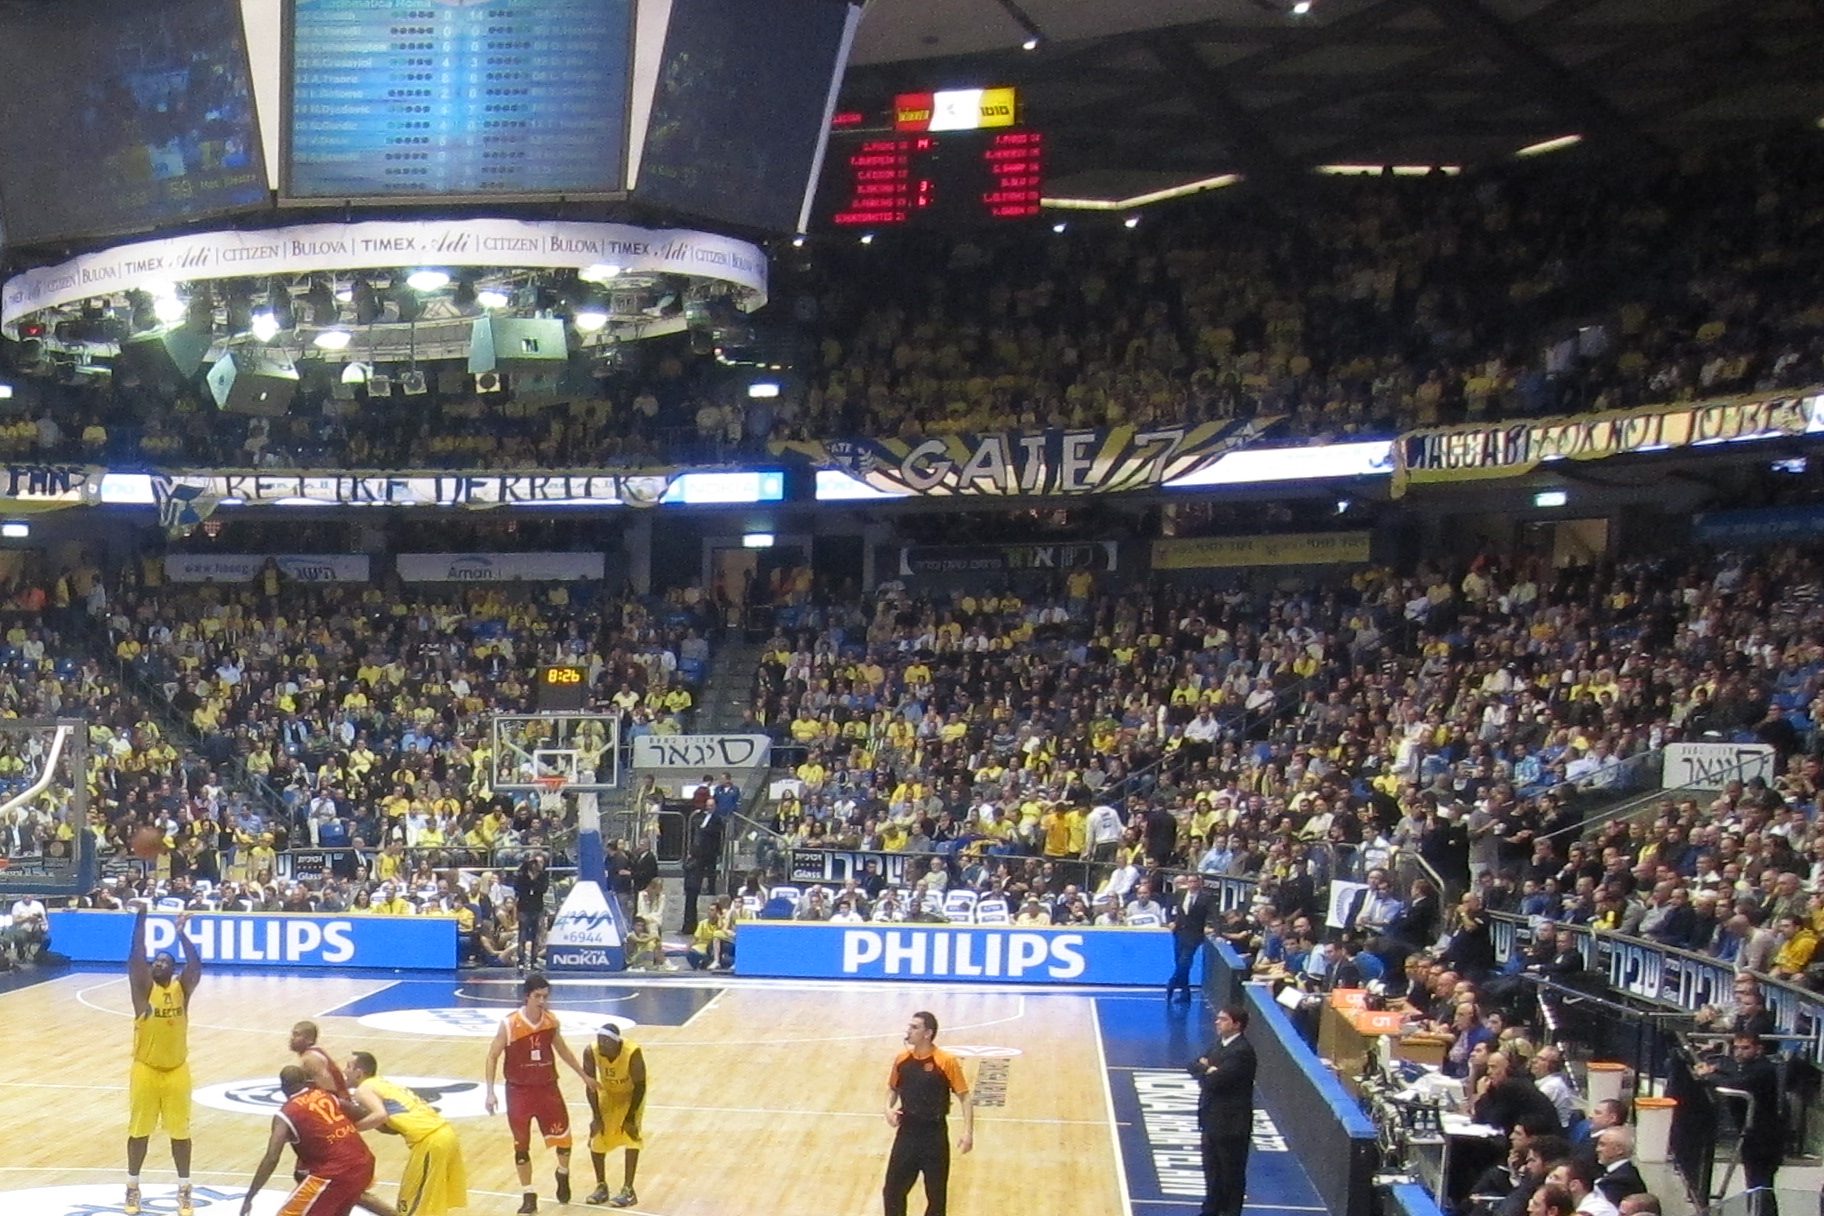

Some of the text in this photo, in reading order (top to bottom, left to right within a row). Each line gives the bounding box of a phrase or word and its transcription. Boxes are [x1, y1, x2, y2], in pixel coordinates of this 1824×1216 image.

[124, 258, 164, 275] TIMEX
[223, 245, 280, 263] CITIZEN
[362, 237, 416, 252] TIMEX
[482, 236, 539, 252] CITIZEN
[609, 240, 651, 256] TIMEX
[898, 430, 1185, 493] GATE 7
[547, 668, 581, 683] 8:26
[649, 737, 755, 766] סיגאר
[296, 871, 322, 881] Glass
[793, 869, 822, 879] Glass
[144, 917, 356, 963] PHILIPS
[842, 930, 1086, 978] PHILIPS
[552, 954, 610, 966] NOKIA
[308, 1098, 345, 1125] 12
